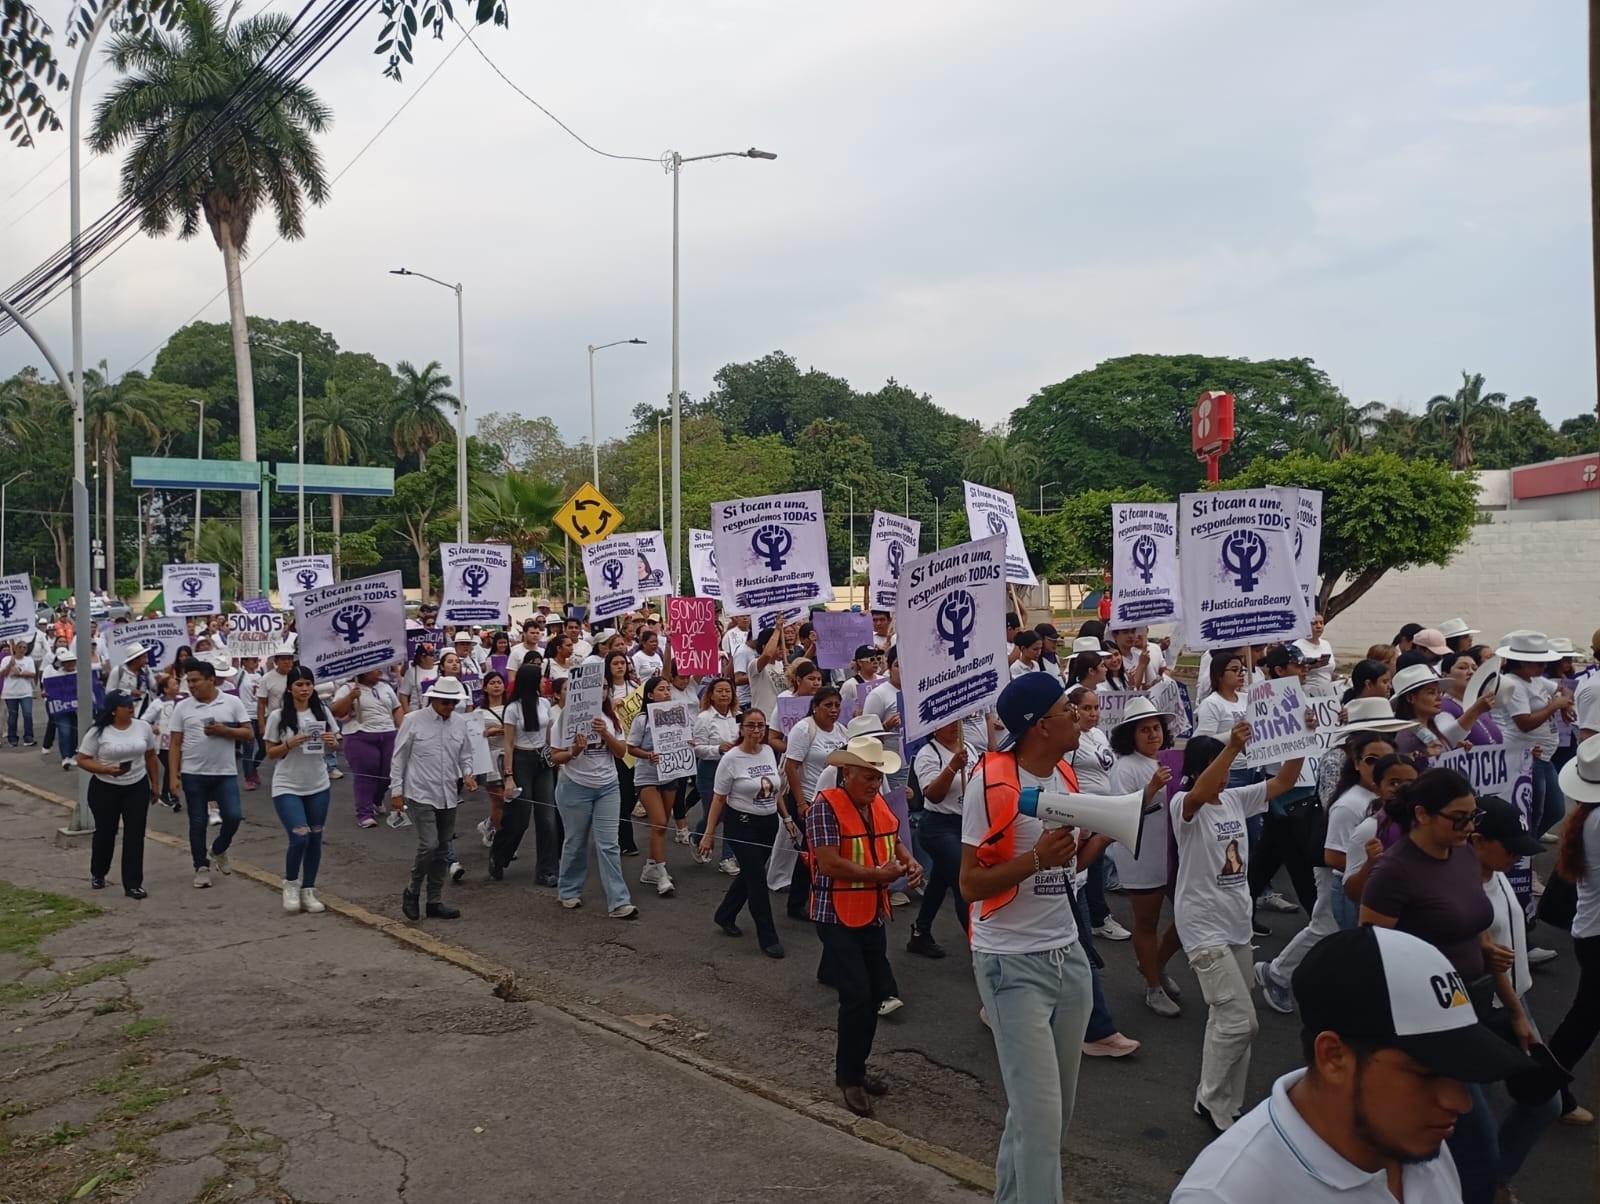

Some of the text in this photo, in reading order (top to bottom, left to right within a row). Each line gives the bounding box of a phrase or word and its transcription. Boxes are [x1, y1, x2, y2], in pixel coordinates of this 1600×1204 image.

[970, 487, 977, 498] Si
[722, 500, 808, 520] Si tocan a una,
[1120, 509, 1128, 524] Si
[1129, 507, 1148, 520] tocan
[1149, 510, 1154, 518] a
[1193, 500, 1208, 518] Si
[1212, 497, 1246, 512] tocan
[1249, 497, 1256, 508] a
[722, 512, 817, 533] respondemos TODAS
[878, 517, 886, 528] Si
[886, 517, 900, 529] tocan
[1154, 522, 1173, 536] TODAS
[1191, 514, 1256, 536] respondemos
[695, 533, 702, 541] Si
[902, 533, 916, 547] TODAS
[448, 547, 458, 558] Si
[459, 546, 480, 554] tocan
[588, 546, 596, 557] Si
[618, 548, 634, 556] TODAS
[486, 557, 508, 568] TODAS
[910, 565, 925, 588] Si
[928, 555, 960, 576] tocan
[962, 553, 968, 564] a
[970, 550, 992, 562] una,
[736, 571, 814, 588] #JusticiaParaBeany
[908, 572, 967, 608] respondemos
[968, 564, 1000, 582] TODAS
[304, 592, 318, 607] Si
[320, 586, 352, 600] tocan
[364, 582, 388, 590] una,
[304, 590, 398, 618] respondemos TODAS
[670, 600, 712, 620] SOMOS
[1200, 595, 1292, 612] #JusticiaParaBeany
[113, 628, 124, 637] Si
[126, 624, 148, 632] tocan
[230, 614, 282, 632] SOMOS
[671, 620, 705, 634] LA VOZ
[157, 628, 184, 636] TODAS
[682, 634, 696, 650] DE
[674, 649, 712, 670] BEANY
[570, 666, 584, 680] TU
[918, 652, 994, 693] #JusticiaParaBeany
[928, 699, 934, 708] Tu
[1255, 702, 1268, 717] NO
